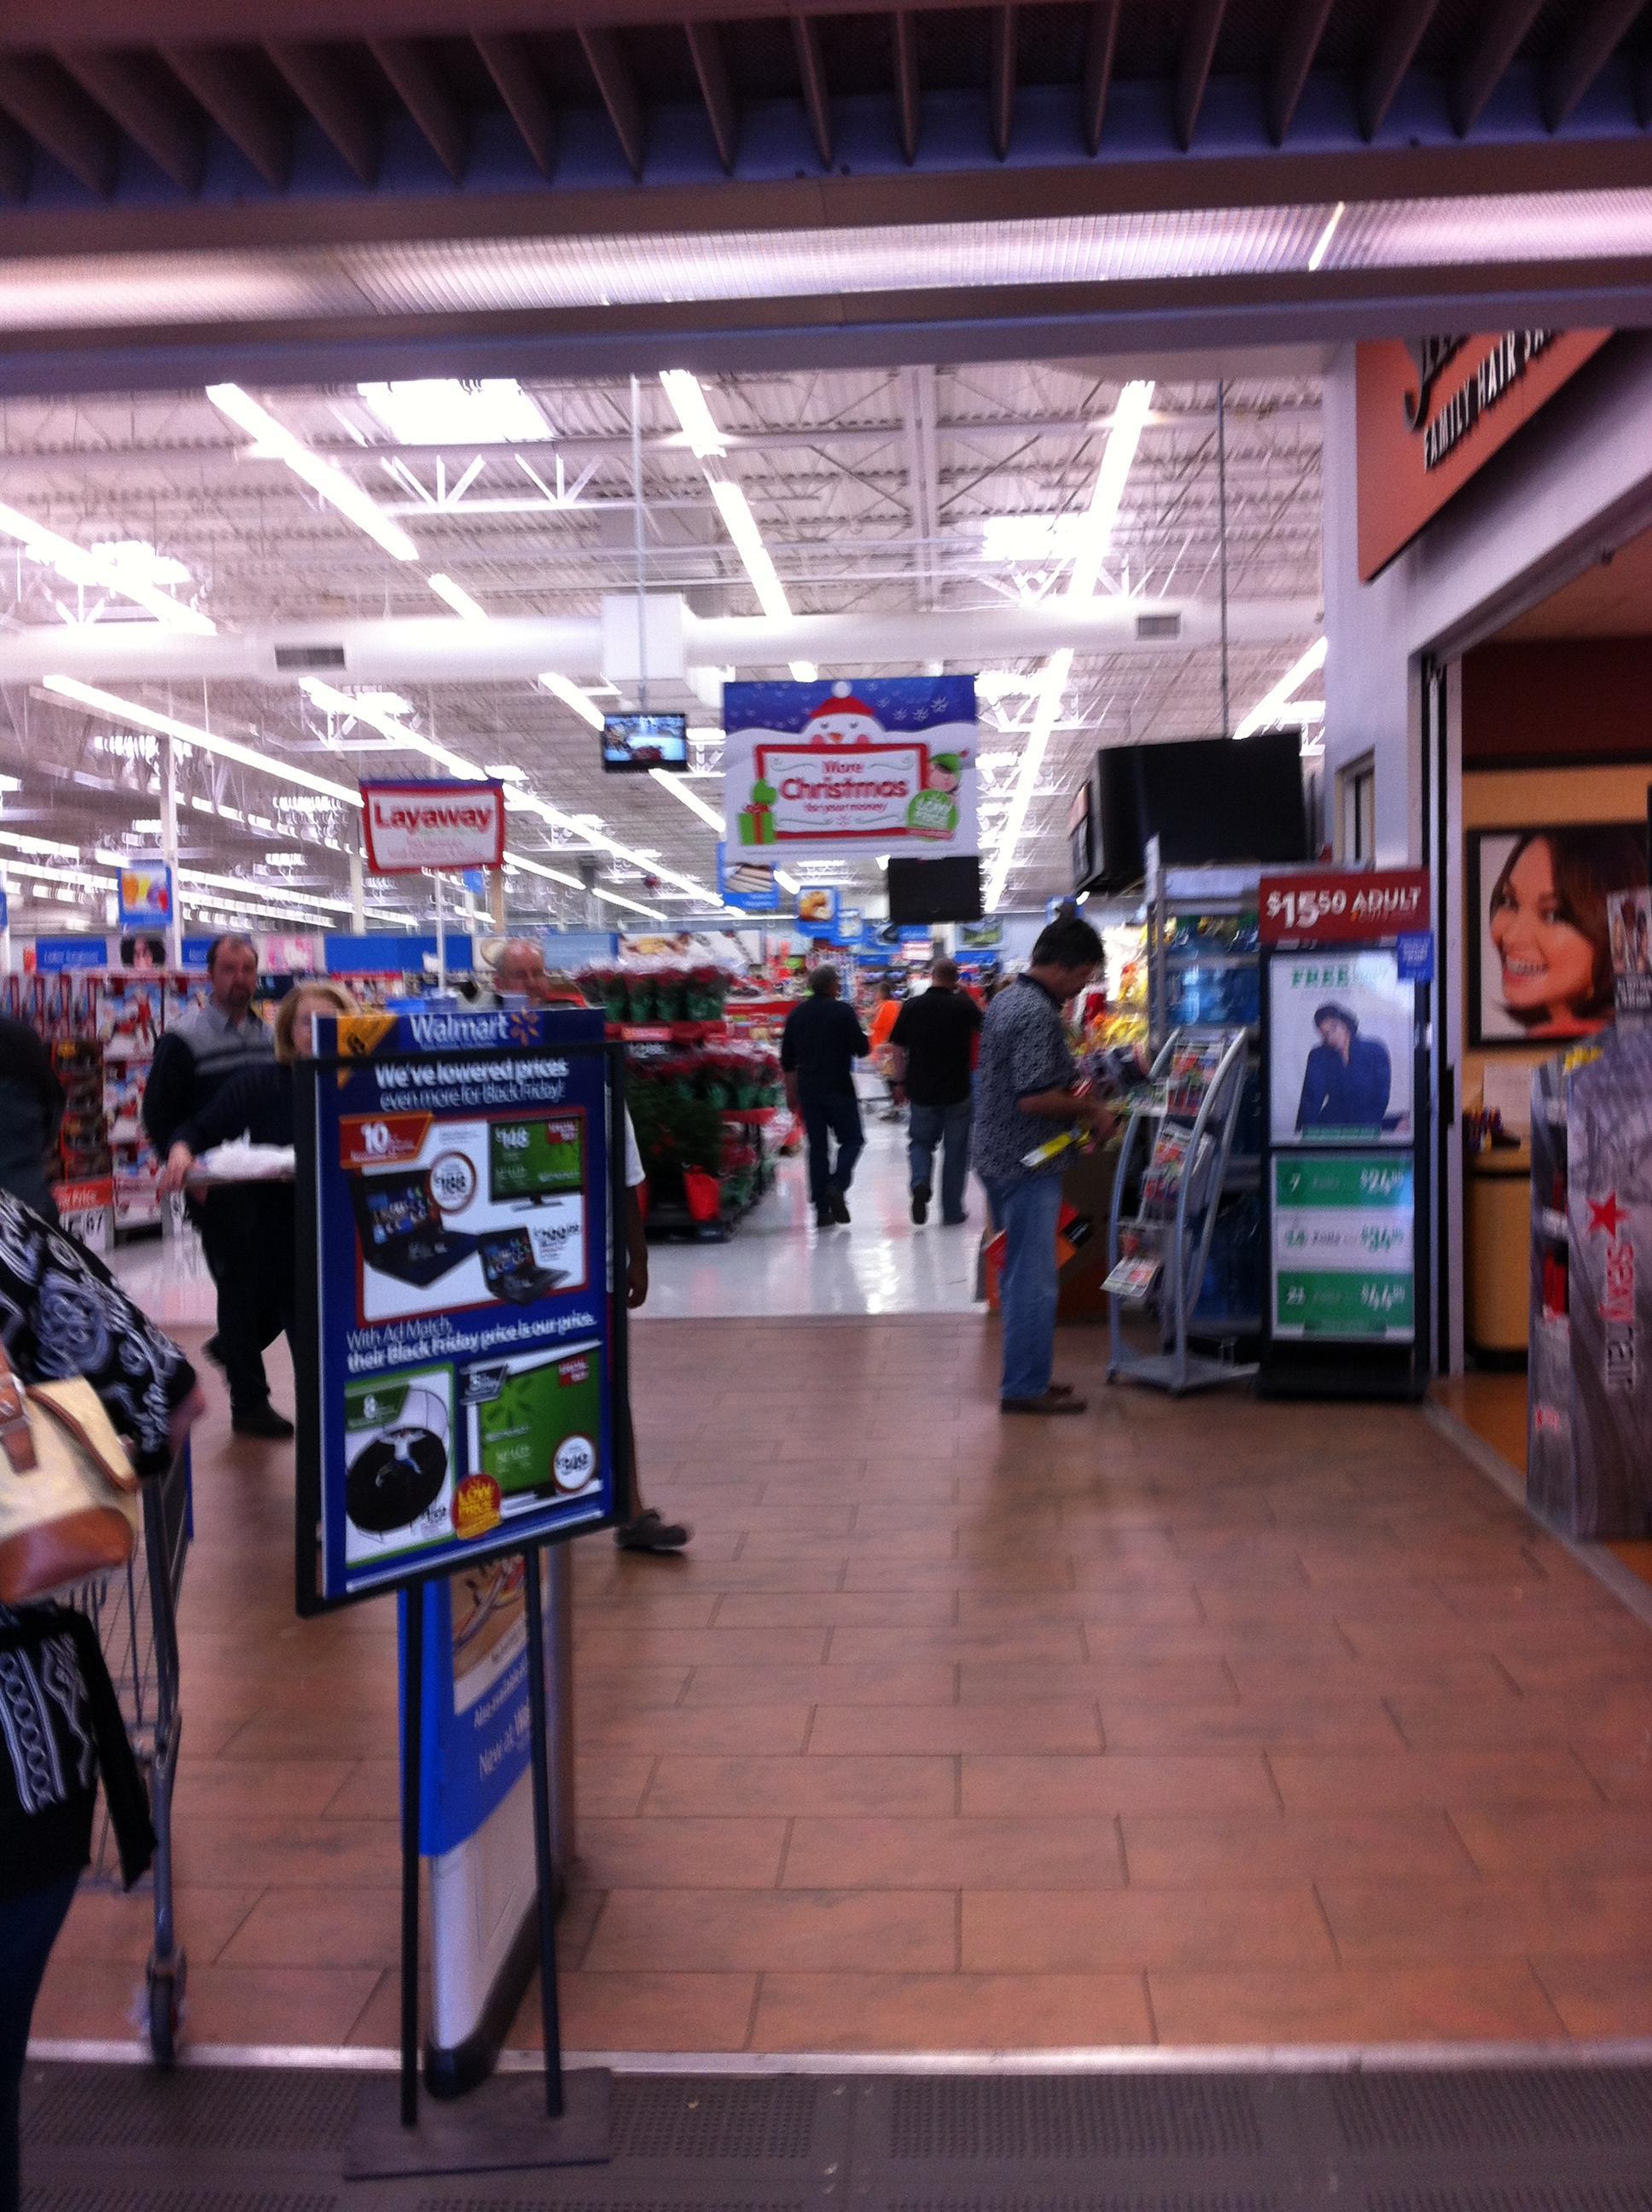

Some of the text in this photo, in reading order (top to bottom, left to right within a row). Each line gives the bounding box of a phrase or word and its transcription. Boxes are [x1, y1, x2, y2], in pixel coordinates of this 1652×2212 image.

[1423, 375, 1470, 474] FAMILY
[1477, 329, 1516, 416] HAIR
[822, 760, 864, 773] More
[779, 777, 910, 800] Christmas
[374, 800, 492, 835] Layaway
[1351, 886, 1422, 915] ADULT
[410, 1011, 509, 1044] Walmart
[375, 1057, 570, 1089] We've lowered prices
[360, 1121, 388, 1155] 10
[346, 1327, 381, 1353] With
[405, 1314, 453, 1341] Match
[346, 1348, 386, 1374] their
[387, 1340, 432, 1365] Black
[431, 1330, 480, 1359] Friday
[480, 1323, 518, 1352] price
